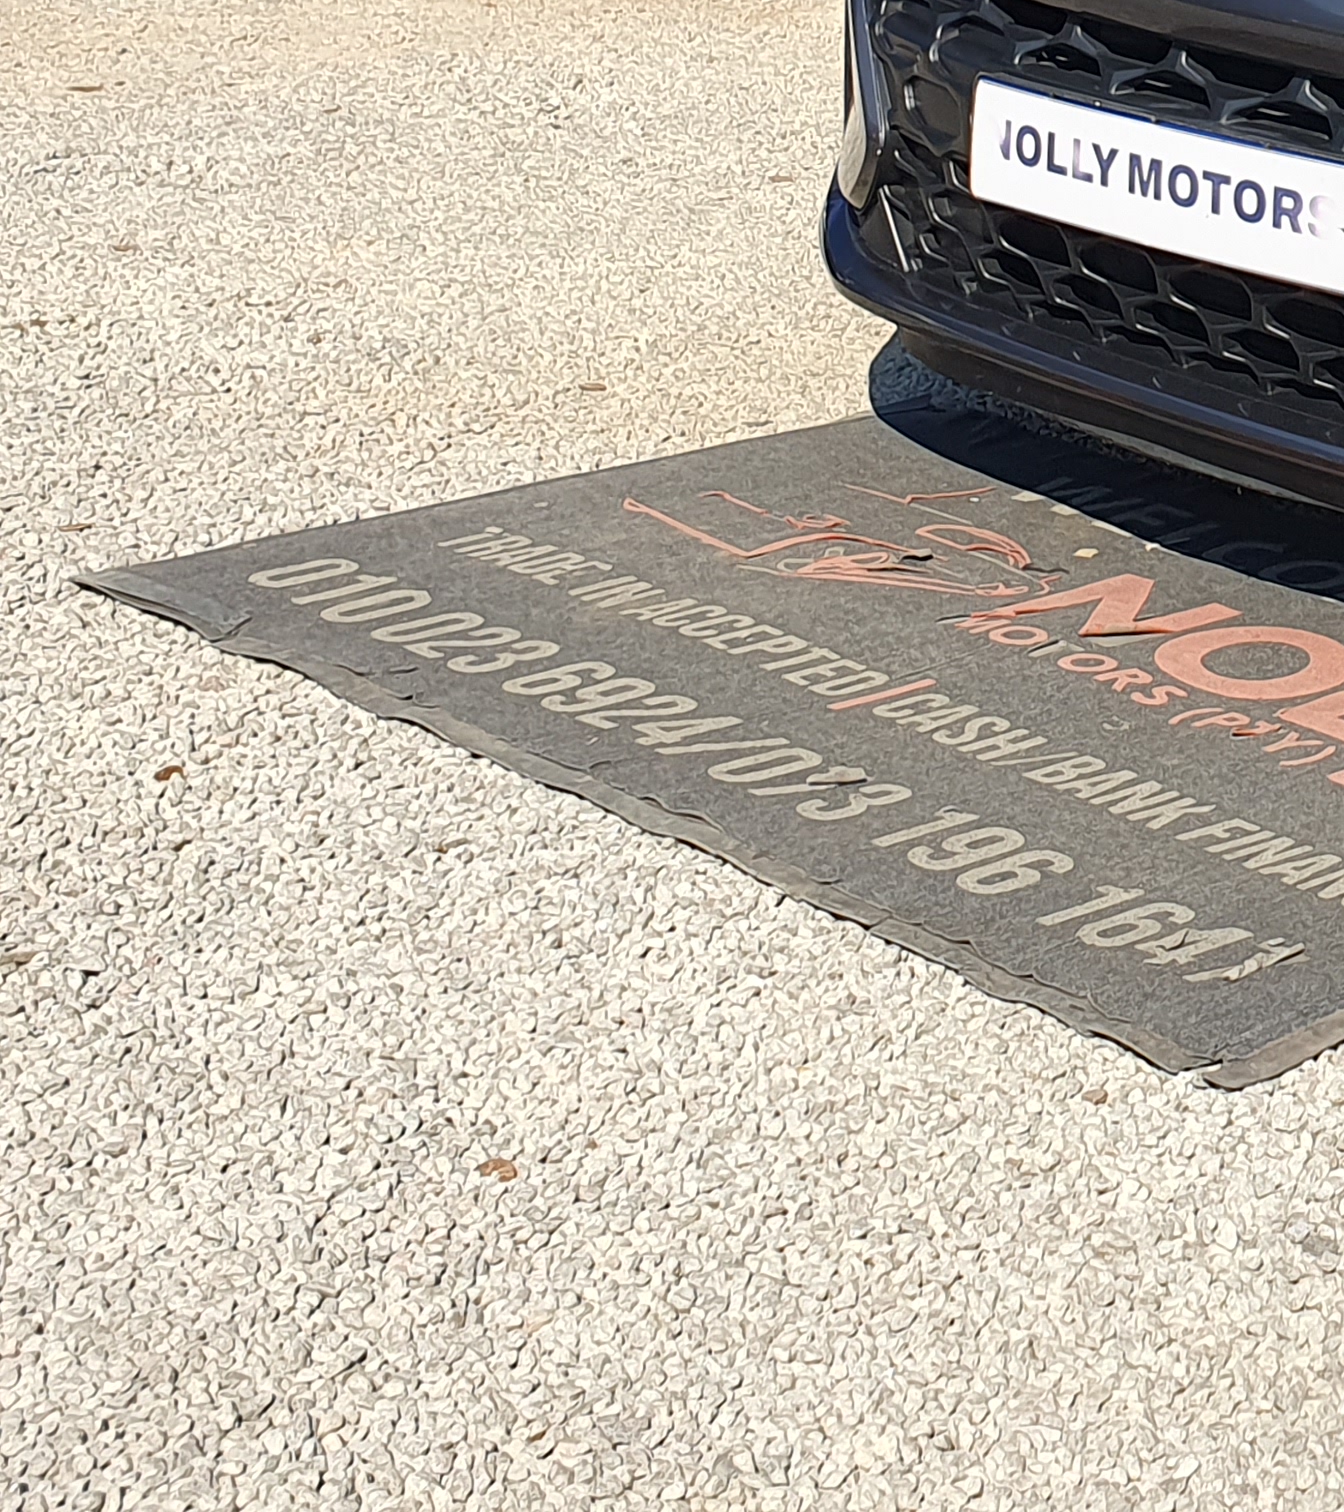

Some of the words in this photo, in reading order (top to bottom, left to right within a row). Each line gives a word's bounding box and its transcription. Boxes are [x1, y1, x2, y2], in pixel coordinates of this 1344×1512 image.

[437, 526, 614, 585] TRADE
[567, 575, 666, 608] IN
[247, 558, 432, 623] 010
[370, 611, 560, 674] 023
[871, 805, 1074, 894] 196
